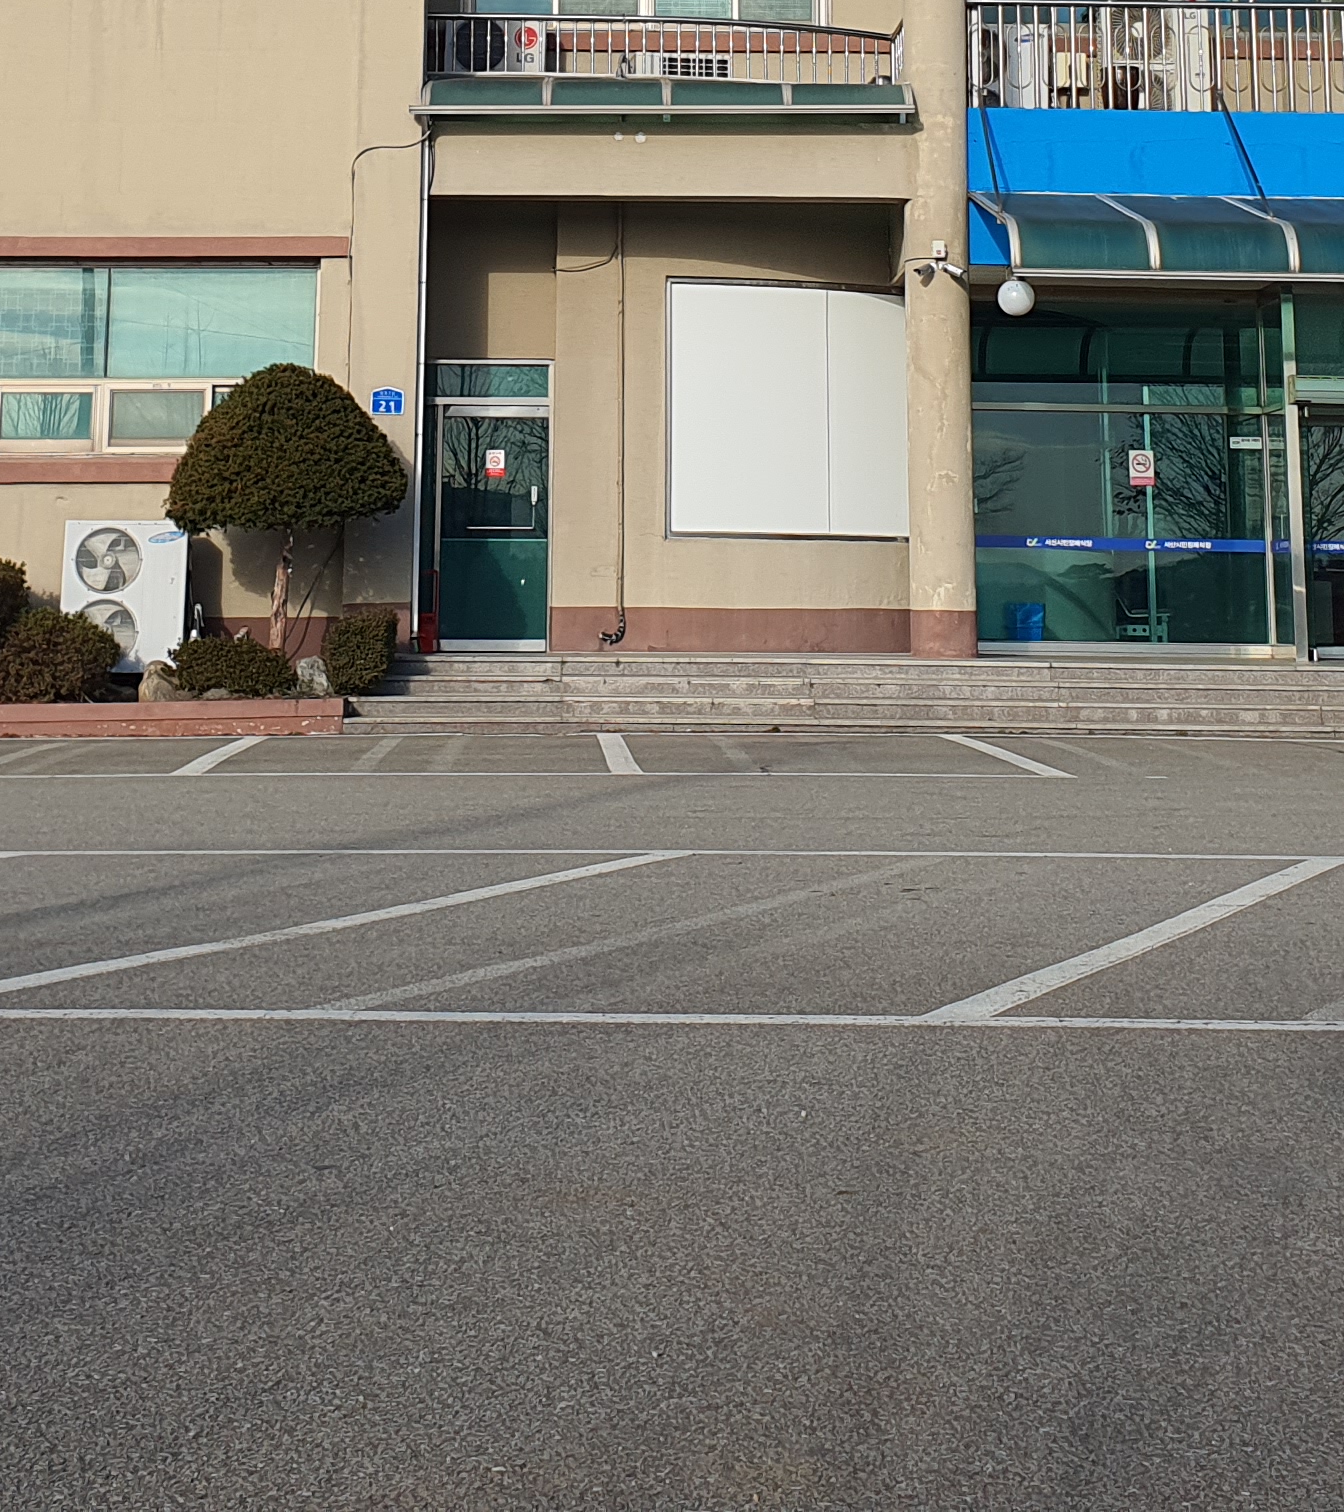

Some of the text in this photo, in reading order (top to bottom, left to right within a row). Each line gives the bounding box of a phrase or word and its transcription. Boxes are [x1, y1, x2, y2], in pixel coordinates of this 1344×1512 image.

[1184, 11, 1196, 20] LG
[516, 52, 535, 64] LG
[378, 400, 395, 413] 21
